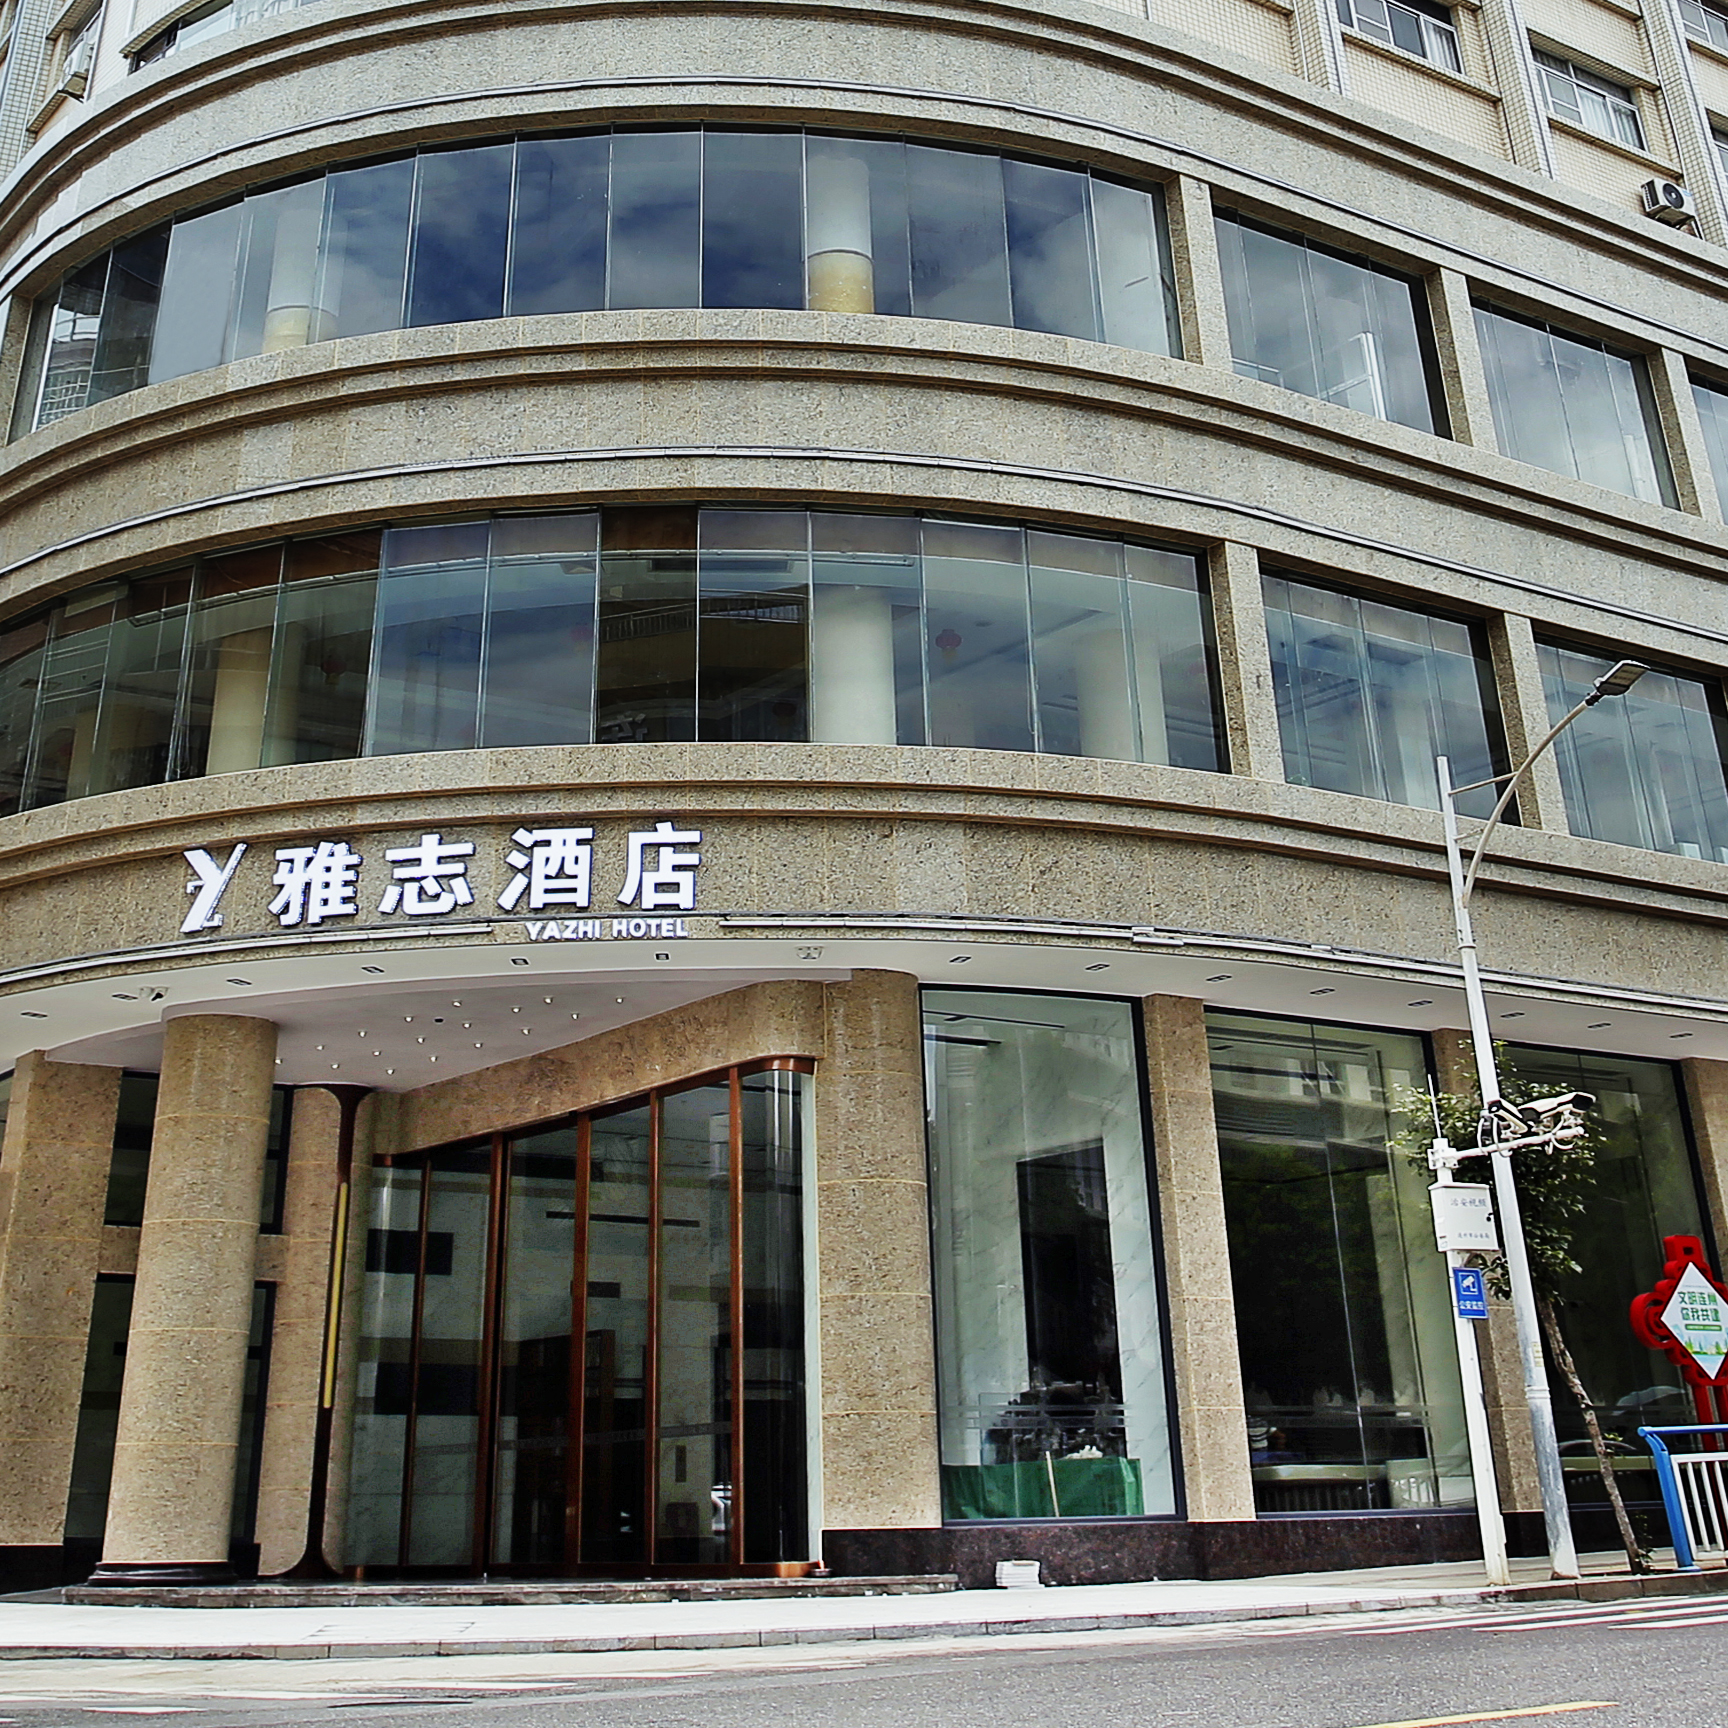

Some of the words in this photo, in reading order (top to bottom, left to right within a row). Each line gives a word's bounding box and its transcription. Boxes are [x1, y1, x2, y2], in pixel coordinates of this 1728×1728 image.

[268, 821, 702, 927] 雅志酒店
[524, 919, 602, 941] YAZHI
[612, 918, 690, 939] HOTEL
